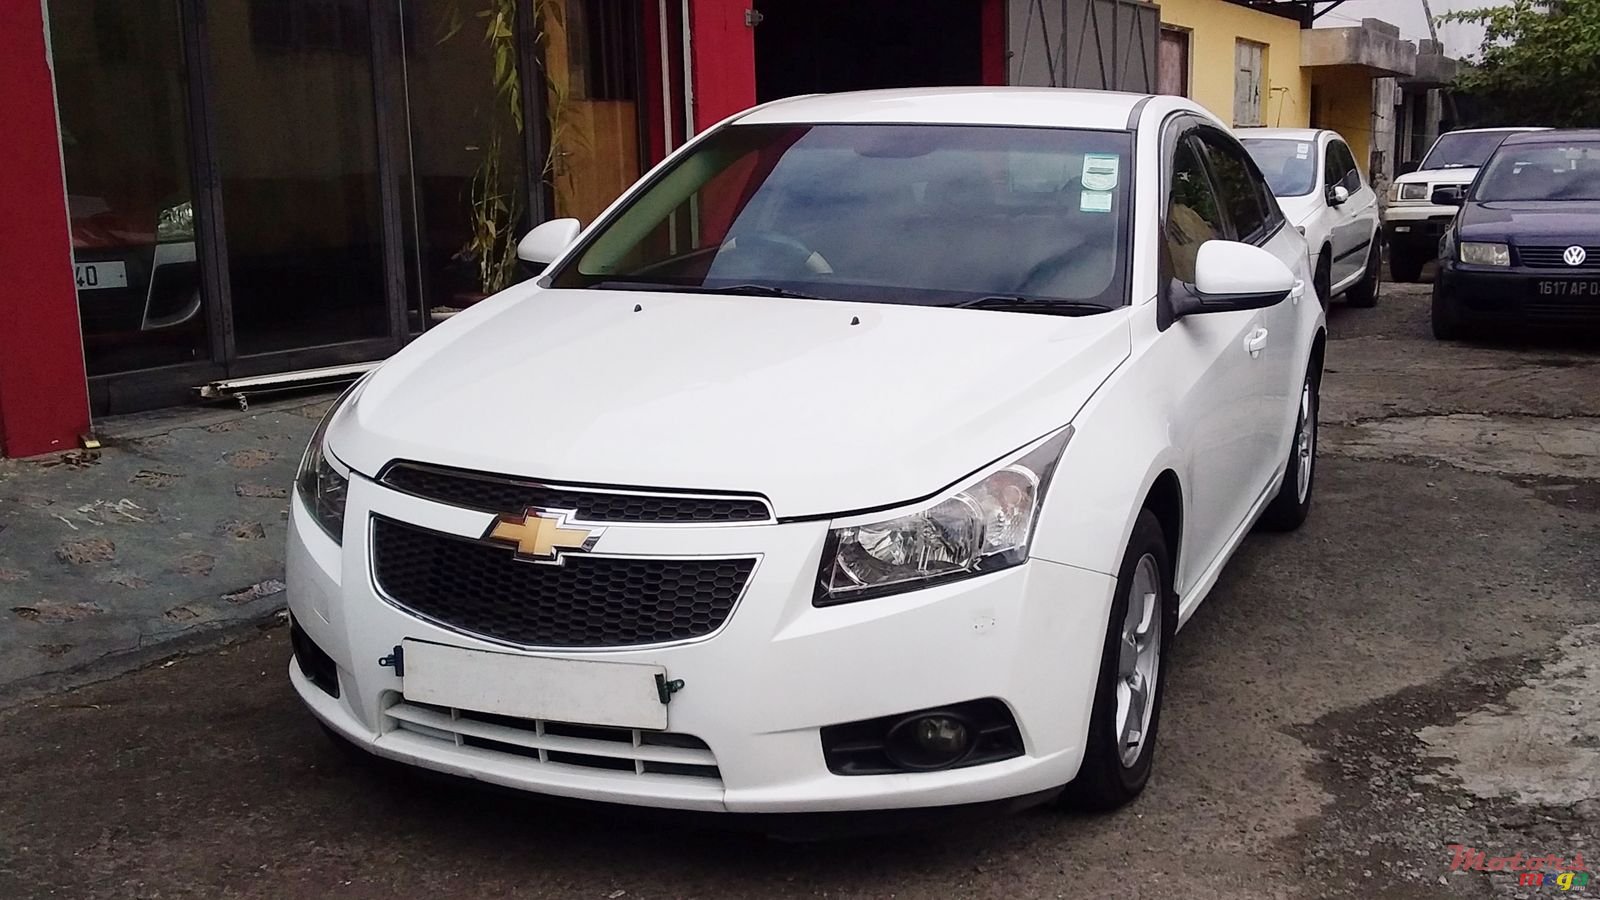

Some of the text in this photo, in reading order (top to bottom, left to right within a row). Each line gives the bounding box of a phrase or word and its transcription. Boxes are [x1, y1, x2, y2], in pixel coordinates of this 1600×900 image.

[1563, 245, 1586, 266] VW
[1538, 281, 1568, 295] 1617
[1570, 281, 1588, 295] AP
